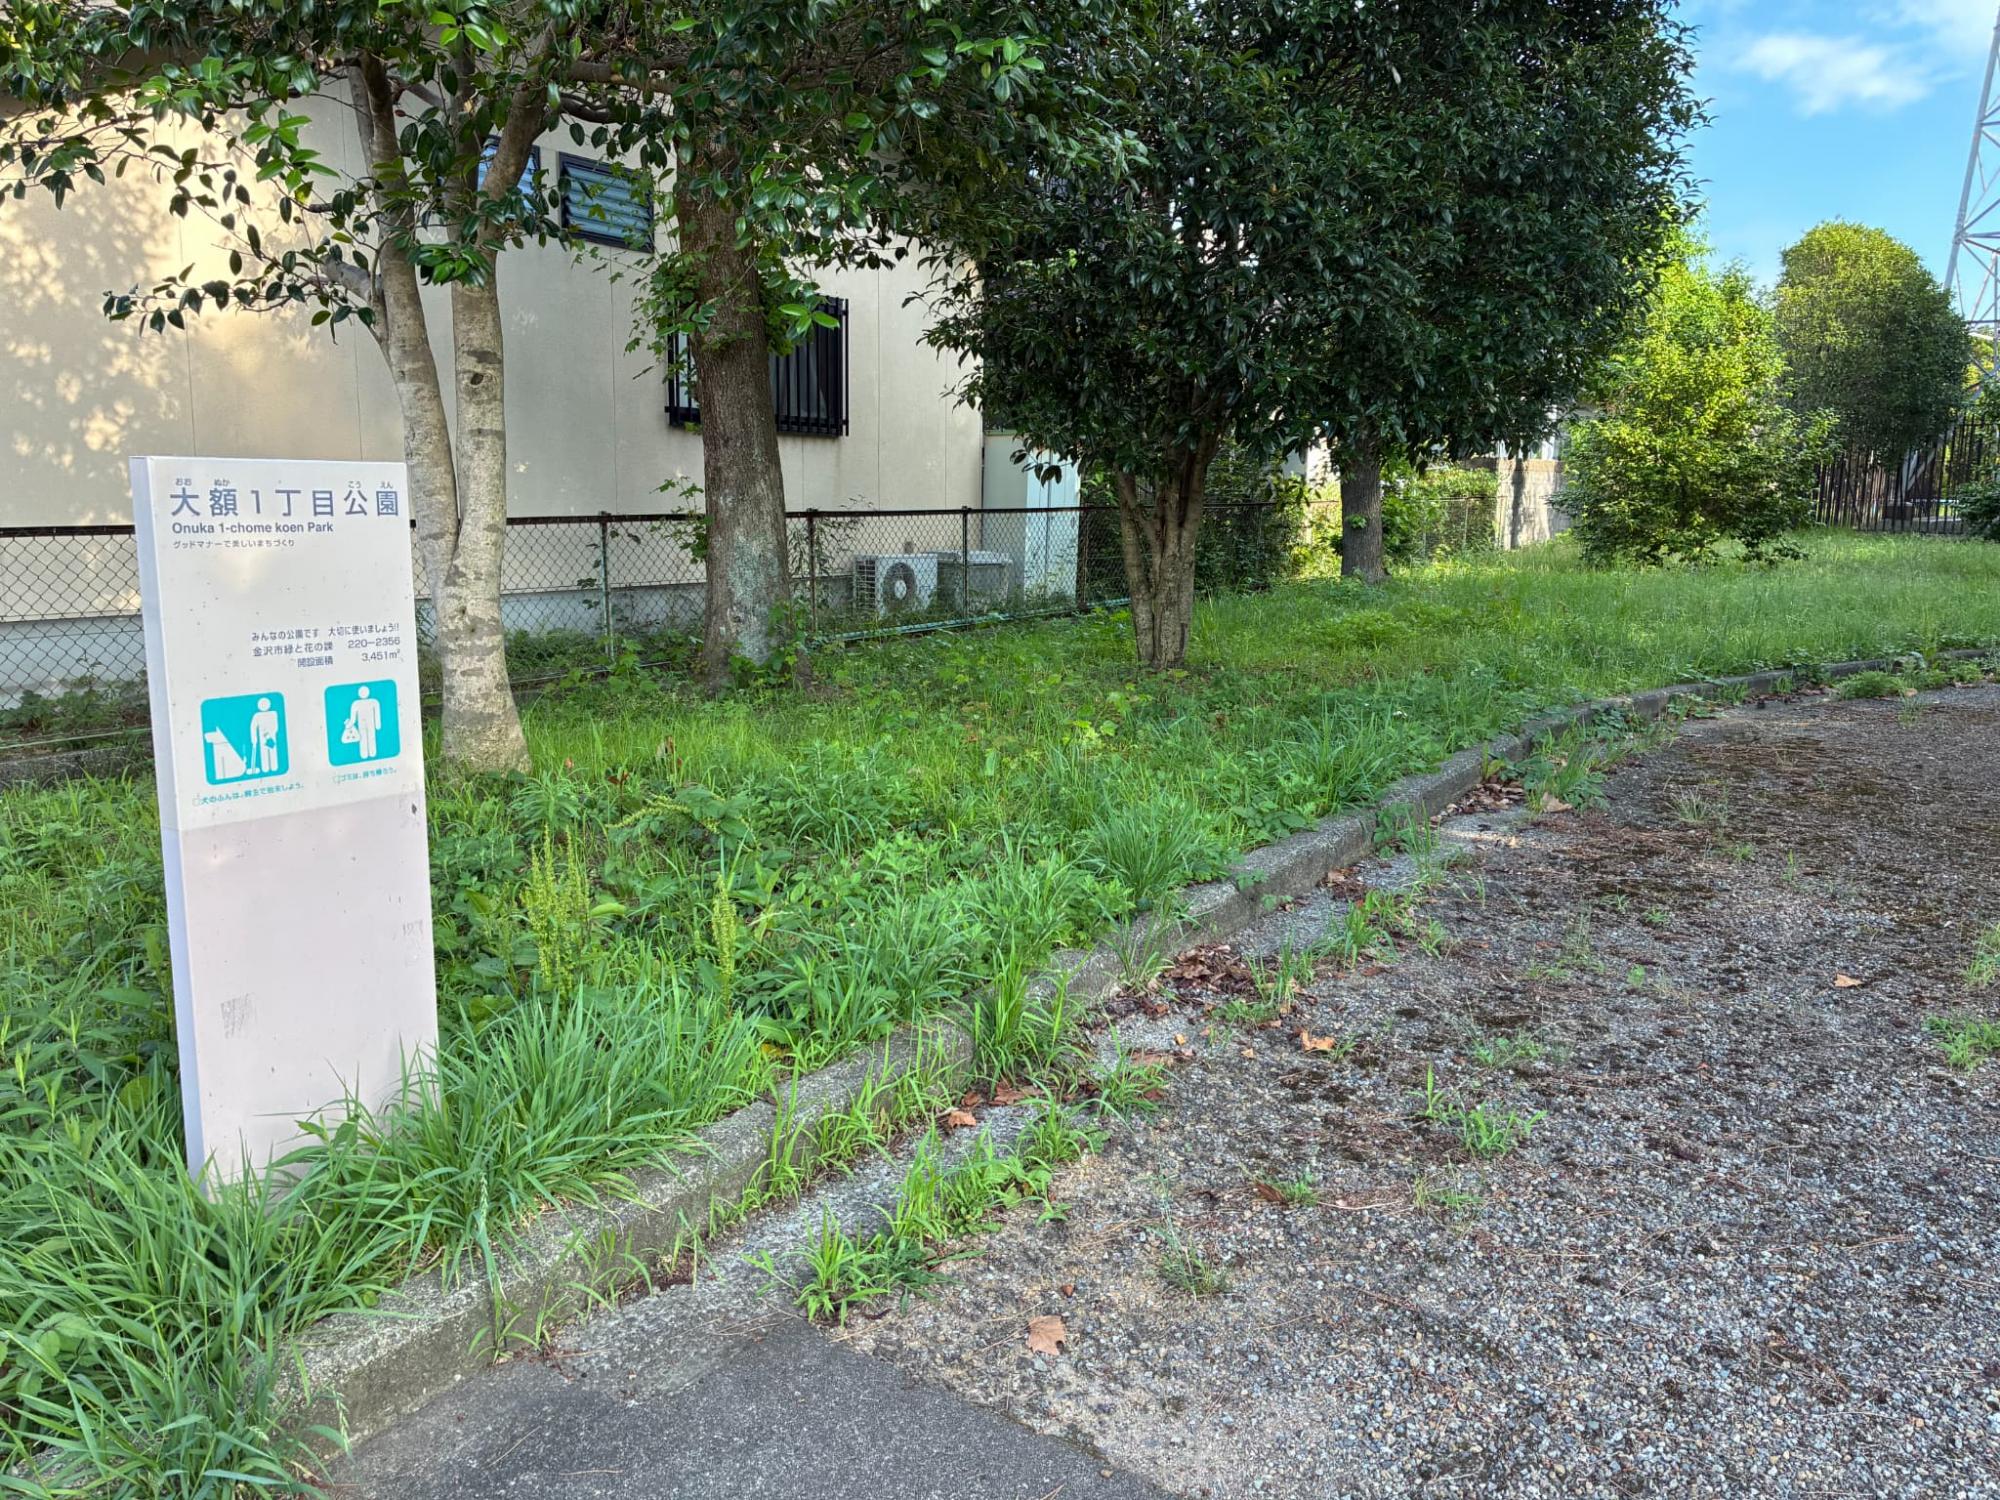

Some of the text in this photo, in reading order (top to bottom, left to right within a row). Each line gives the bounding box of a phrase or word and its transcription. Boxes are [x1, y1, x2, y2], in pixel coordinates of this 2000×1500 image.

[175, 478, 192, 486] おお
[348, 481, 362, 489] こう
[380, 481, 394, 489] えん
[170, 487, 398, 517] 大額1丁目公園
[172, 522, 334, 534] Onuka 1-chome koen Park
[173, 539, 295, 549] グッドマナーで美しいまちづくり
[251, 628, 320, 641] みんなの公園です
[252, 641, 333, 657] 金沢市緑と花の課
